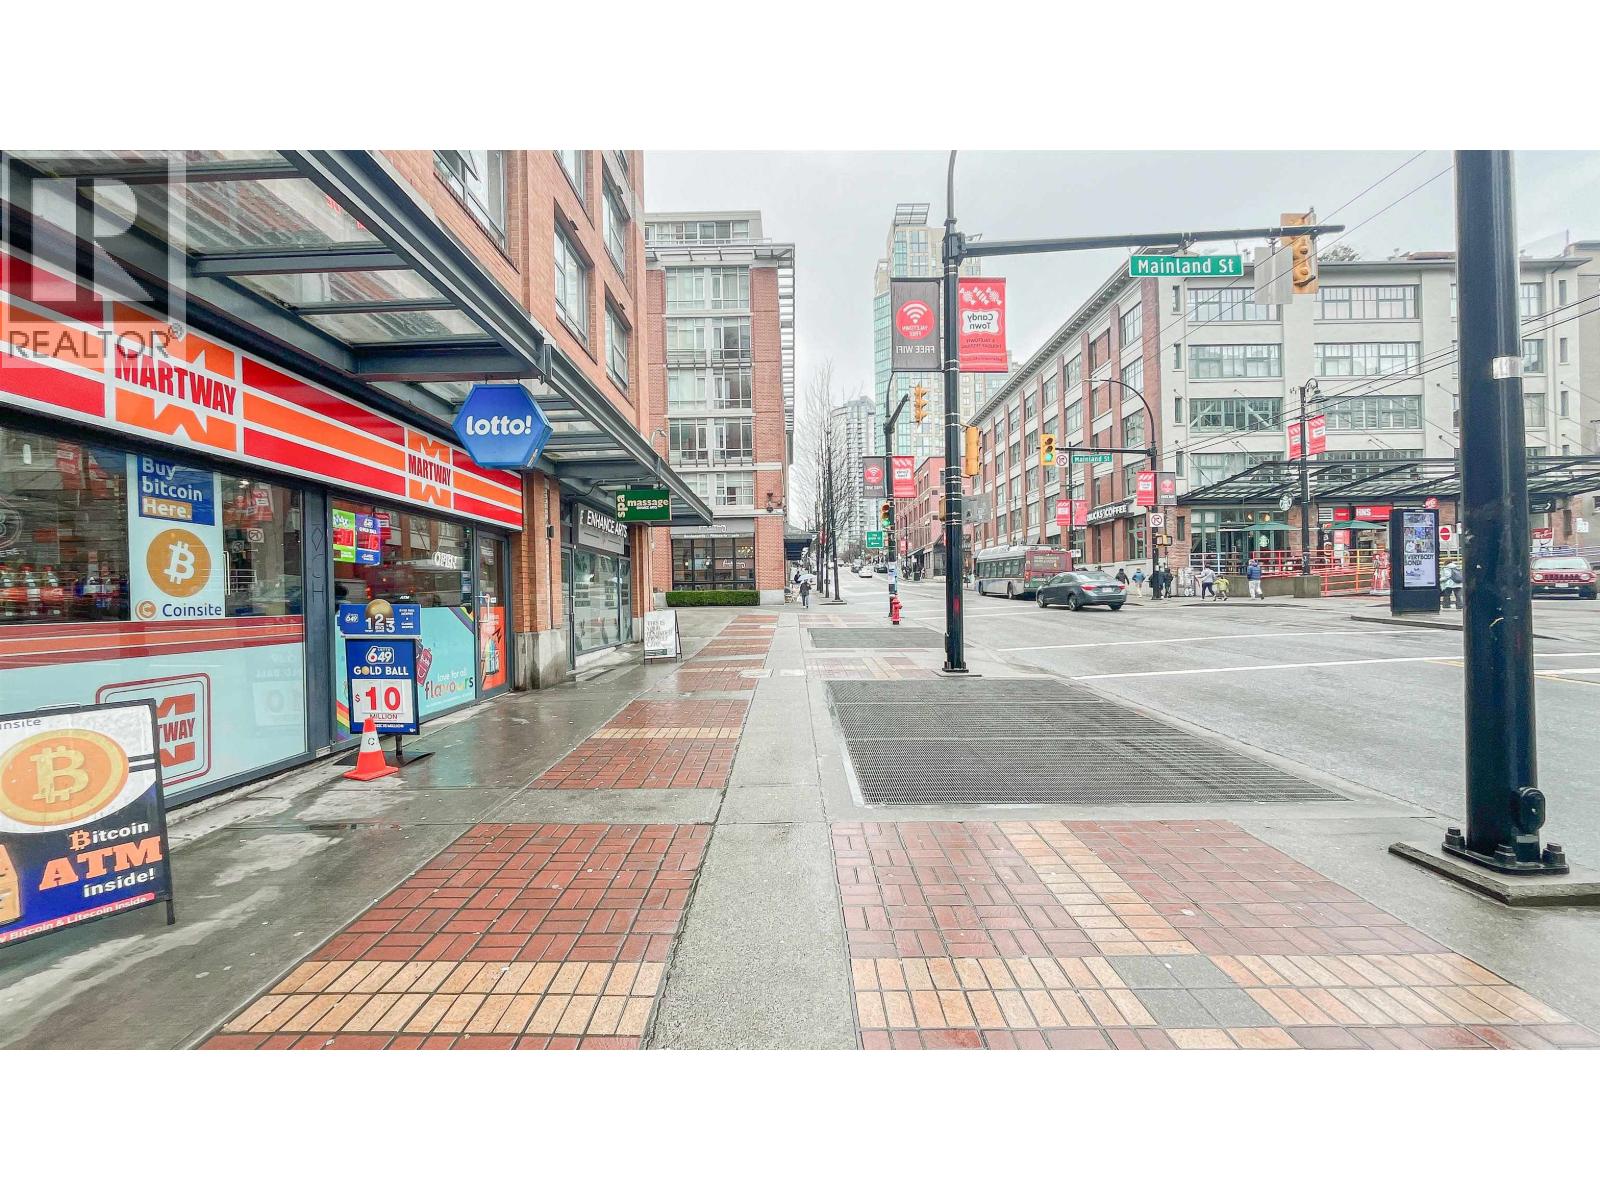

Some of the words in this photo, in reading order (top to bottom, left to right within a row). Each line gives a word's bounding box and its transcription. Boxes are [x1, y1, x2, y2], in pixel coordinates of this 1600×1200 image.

[1138, 258, 1212, 275] Mainland
[1218, 257, 1235, 274] St
[114, 343, 237, 416] MARTWAY
[465, 414, 533, 436] lotto!
[142, 457, 176, 480] Buy
[408, 453, 451, 486] MARTWAY
[141, 475, 203, 502] bitcoin
[142, 497, 192, 520] Here.
[617, 494, 628, 518] spa
[627, 499, 669, 508] massage
[1105, 504, 1127, 518] COFFEE
[587, 510, 615, 534] ENHANCE
[615, 522, 628, 539] ARTS
[162, 602, 222, 617] Coinsite
[353, 665, 382, 676] GOLD
[385, 666, 409, 676] BALL
[365, 686, 401, 711] 10
[369, 712, 398, 720] MILLION
[69, 822, 149, 851] Bitcoin
[39, 836, 163, 891] ATM
[83, 868, 155, 898] inside!
[9, 923, 54, 940] Bitcoin
[55, 919, 65, 927] &
[67, 906, 114, 924] Litecoin
